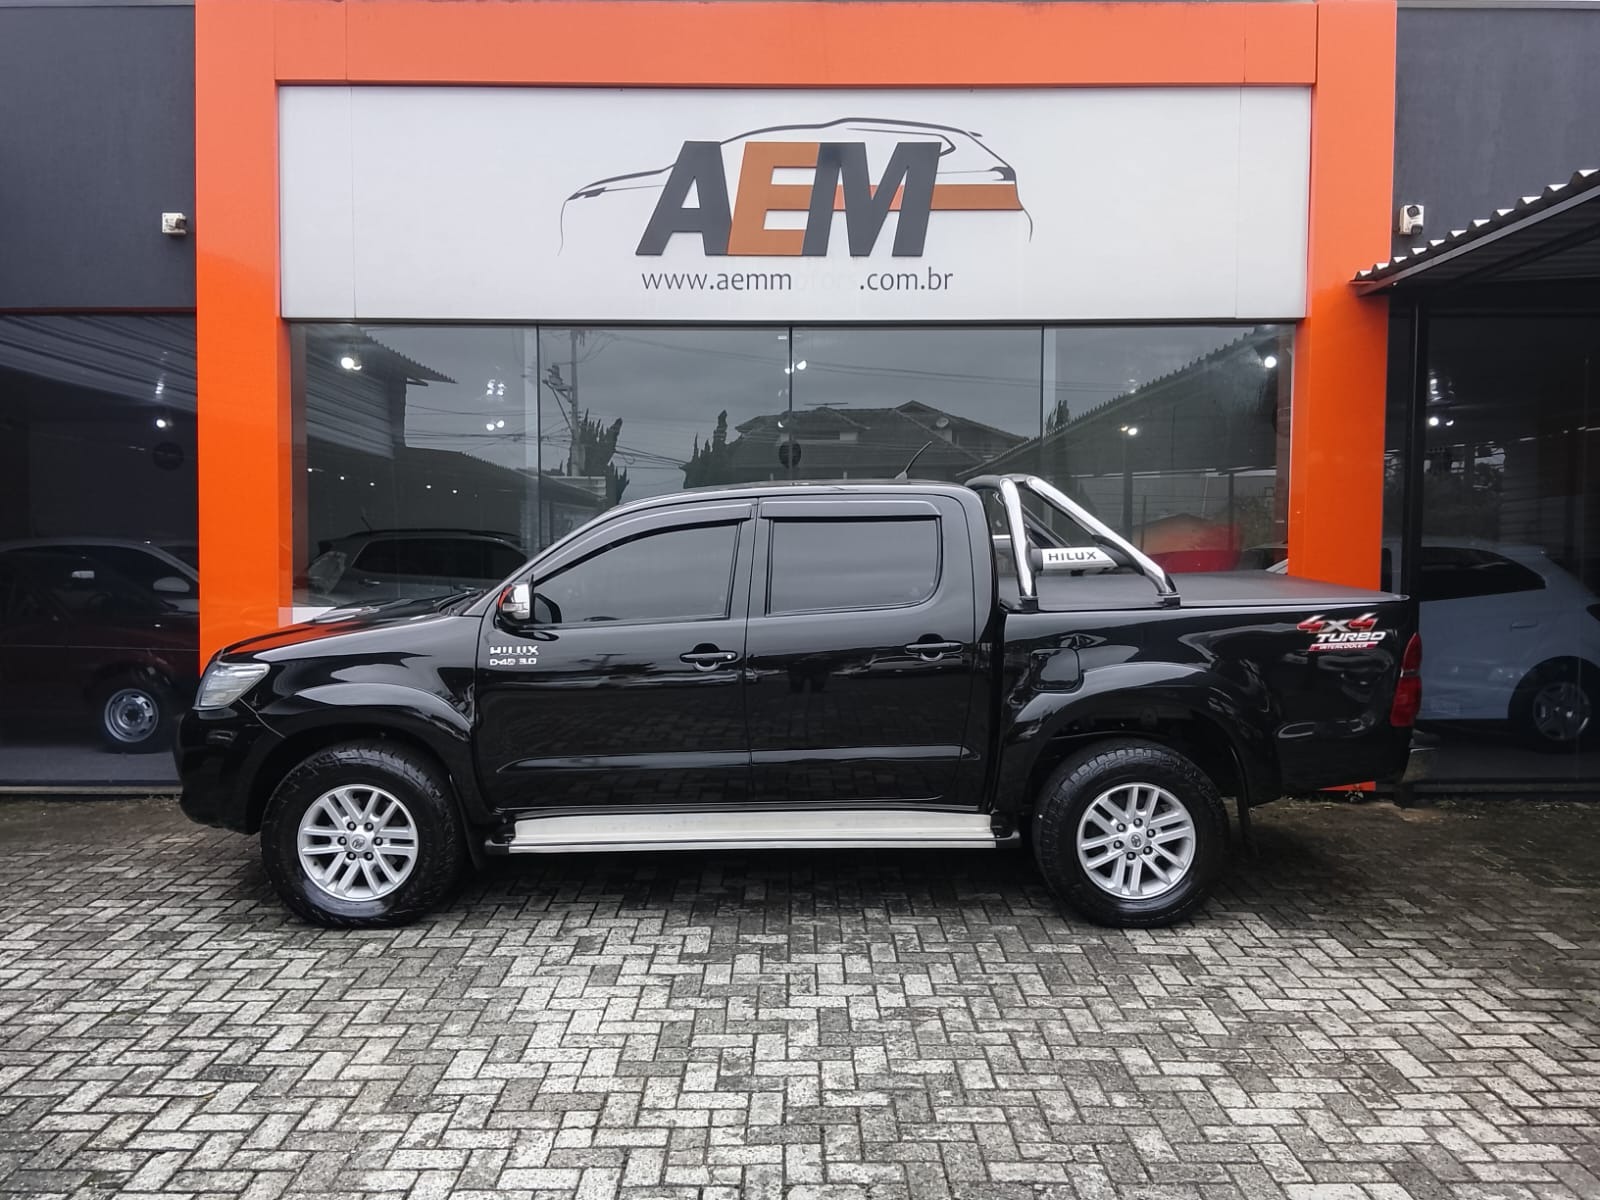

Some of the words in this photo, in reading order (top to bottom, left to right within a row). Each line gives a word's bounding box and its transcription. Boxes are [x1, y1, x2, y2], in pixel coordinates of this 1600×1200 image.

[636, 140, 942, 257] AEM
[1048, 551, 1097, 561] HILUX
[1317, 631, 1387, 643] TURBO
[489, 645, 539, 656] HILUX
